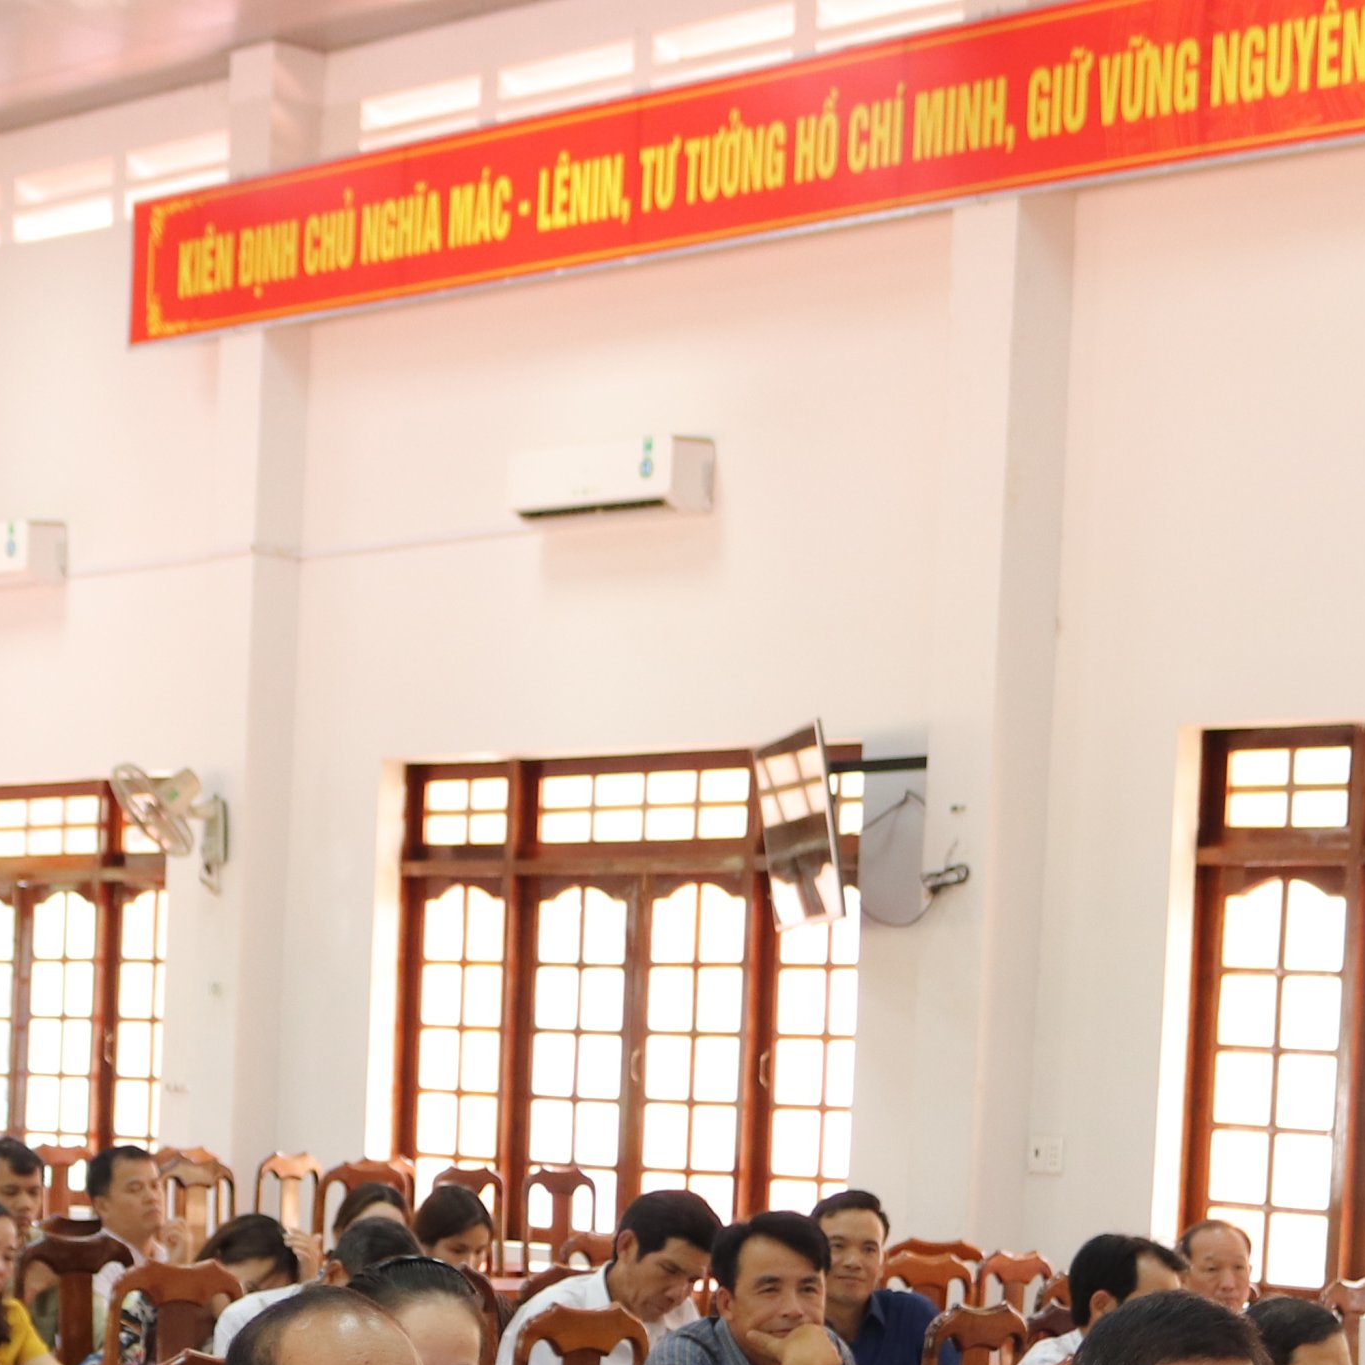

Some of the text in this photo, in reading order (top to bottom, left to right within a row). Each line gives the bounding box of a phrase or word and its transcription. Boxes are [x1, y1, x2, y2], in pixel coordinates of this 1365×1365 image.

[177, 223, 233, 299] KIÊN
[238, 219, 299, 298] ĐỊNH
[303, 188, 356, 276] CHỦ
[360, 181, 442, 265] NGHĨA
[447, 166, 513, 249] MÁC
[536, 151, 631, 232] LÊNIN,
[639, 135, 681, 213] TƯ
[684, 108, 787, 205] TƯỞNG
[793, 87, 840, 184] HỒ
[846, 82, 905, 175] CHÍ
[911, 76, 1016, 162] MINH,
[1026, 47, 1094, 140] GIỮ
[1099, 34, 1201, 126] VỮNG
